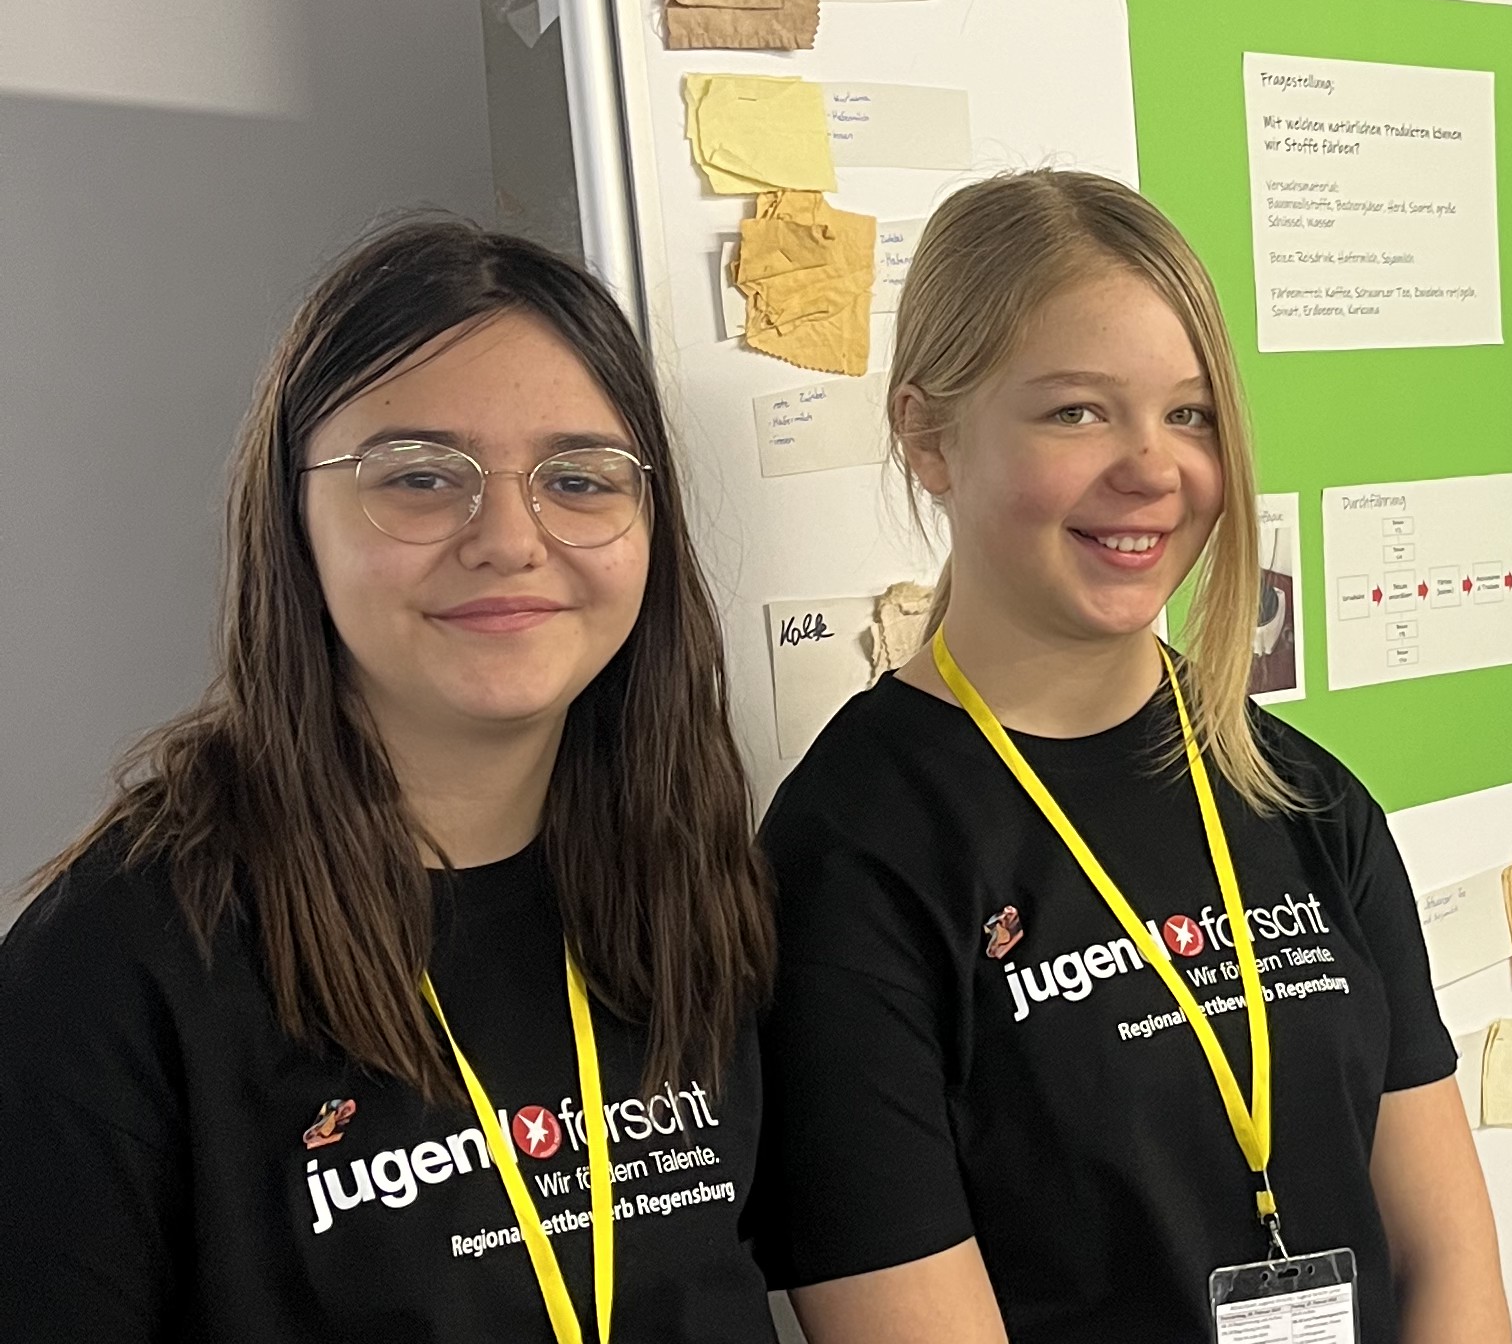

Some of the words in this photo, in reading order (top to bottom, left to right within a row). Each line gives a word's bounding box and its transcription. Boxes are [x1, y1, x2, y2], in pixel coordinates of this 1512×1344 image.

[1263, 115, 1282, 130] Mit
[1285, 116, 1325, 133] welchen
[1328, 119, 1381, 137] natürlichen
[1384, 123, 1430, 139] Produkten
[1285, 137, 1318, 153] Stoffe
[1322, 138, 1360, 155] färben?
[1342, 494, 1406, 511] Durchführung
[1187, 965, 1218, 988] Wir
[1220, 956, 1284, 981] föern
[1275, 974, 1350, 1001] Regensburg
[534, 1173, 571, 1198] Wir
[648, 1145, 722, 1175] Talente.
[635, 1181, 736, 1216] Regensburg
